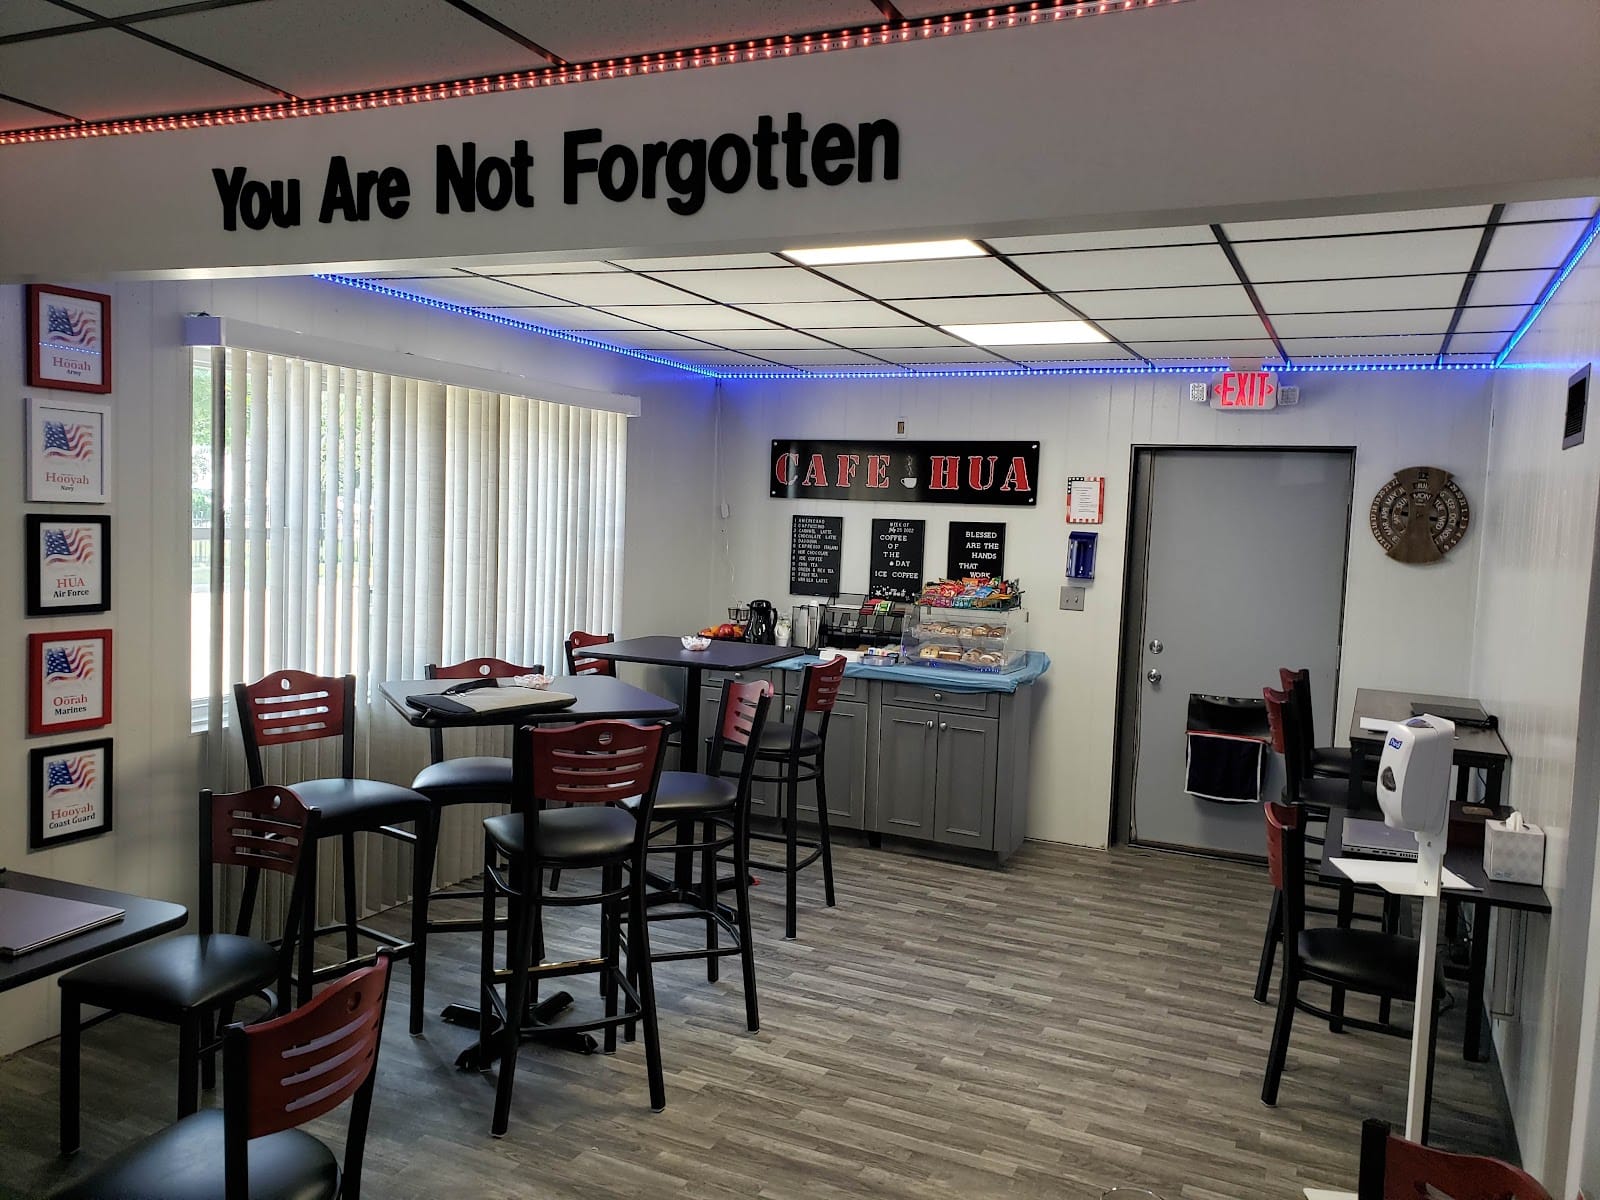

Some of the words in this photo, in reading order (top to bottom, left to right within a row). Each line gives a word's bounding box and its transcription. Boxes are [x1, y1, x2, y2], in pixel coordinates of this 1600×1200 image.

[212, 166, 300, 231] You
[319, 156, 410, 224] Are
[436, 139, 535, 214] Not
[564, 112, 900, 216] Forgotten
[53, 357, 91, 371] Hooah
[1222, 373, 1270, 407] EXIT
[775, 452, 891, 489] CAFE
[929, 456, 1031, 491] HUA
[45, 472, 89, 486] Hooyah
[1386, 491, 1398, 505] MAY
[1413, 492, 1431, 500] MON
[965, 531, 997, 539] BLESSED
[971, 552, 997, 560] HANDS
[959, 562, 979, 570] THAT
[892, 571, 919, 579] COFFEE
[969, 571, 991, 579] WORK
[57, 578, 85, 588] HUA
[53, 589, 66, 598] Air
[67, 588, 89, 597] Force
[53, 694, 88, 707] Oorah
[55, 706, 87, 716] Marines
[51, 803, 94, 820] Hooyah
[49, 817, 71, 830] Coast
[72, 813, 96, 825] Guard
